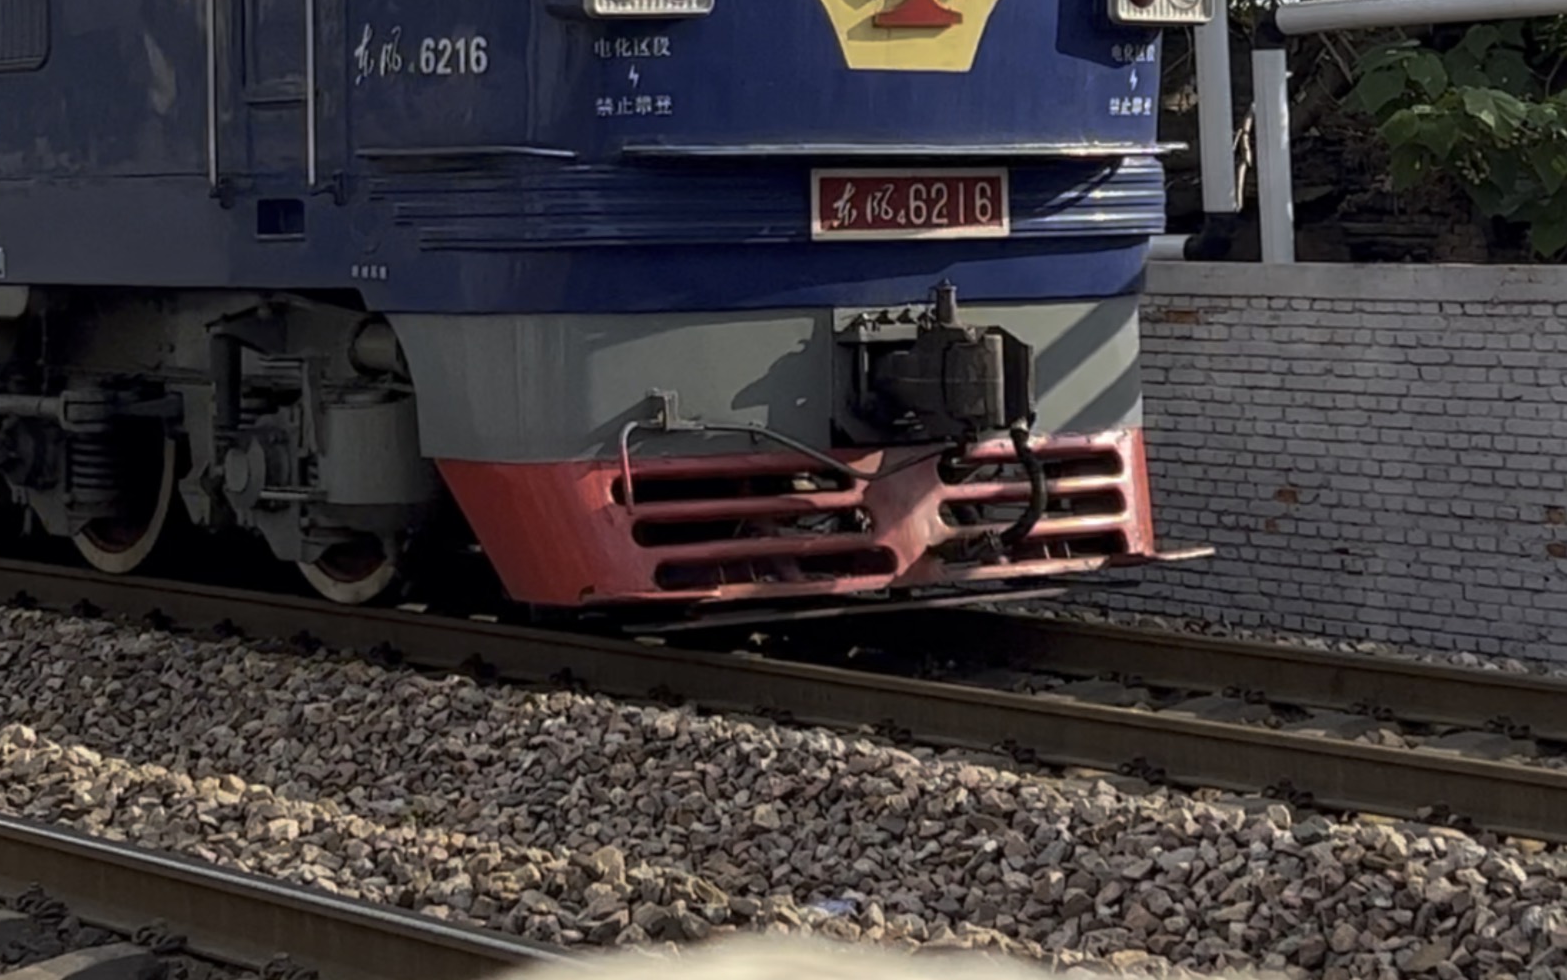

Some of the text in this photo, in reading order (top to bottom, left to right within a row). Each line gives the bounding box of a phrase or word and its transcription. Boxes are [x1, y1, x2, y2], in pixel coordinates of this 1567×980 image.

[419, 36, 489, 74] 6216
[593, 36, 671, 58] 电化区段
[595, 94, 673, 117] 禁止攀登
[908, 181, 993, 225] 6216
